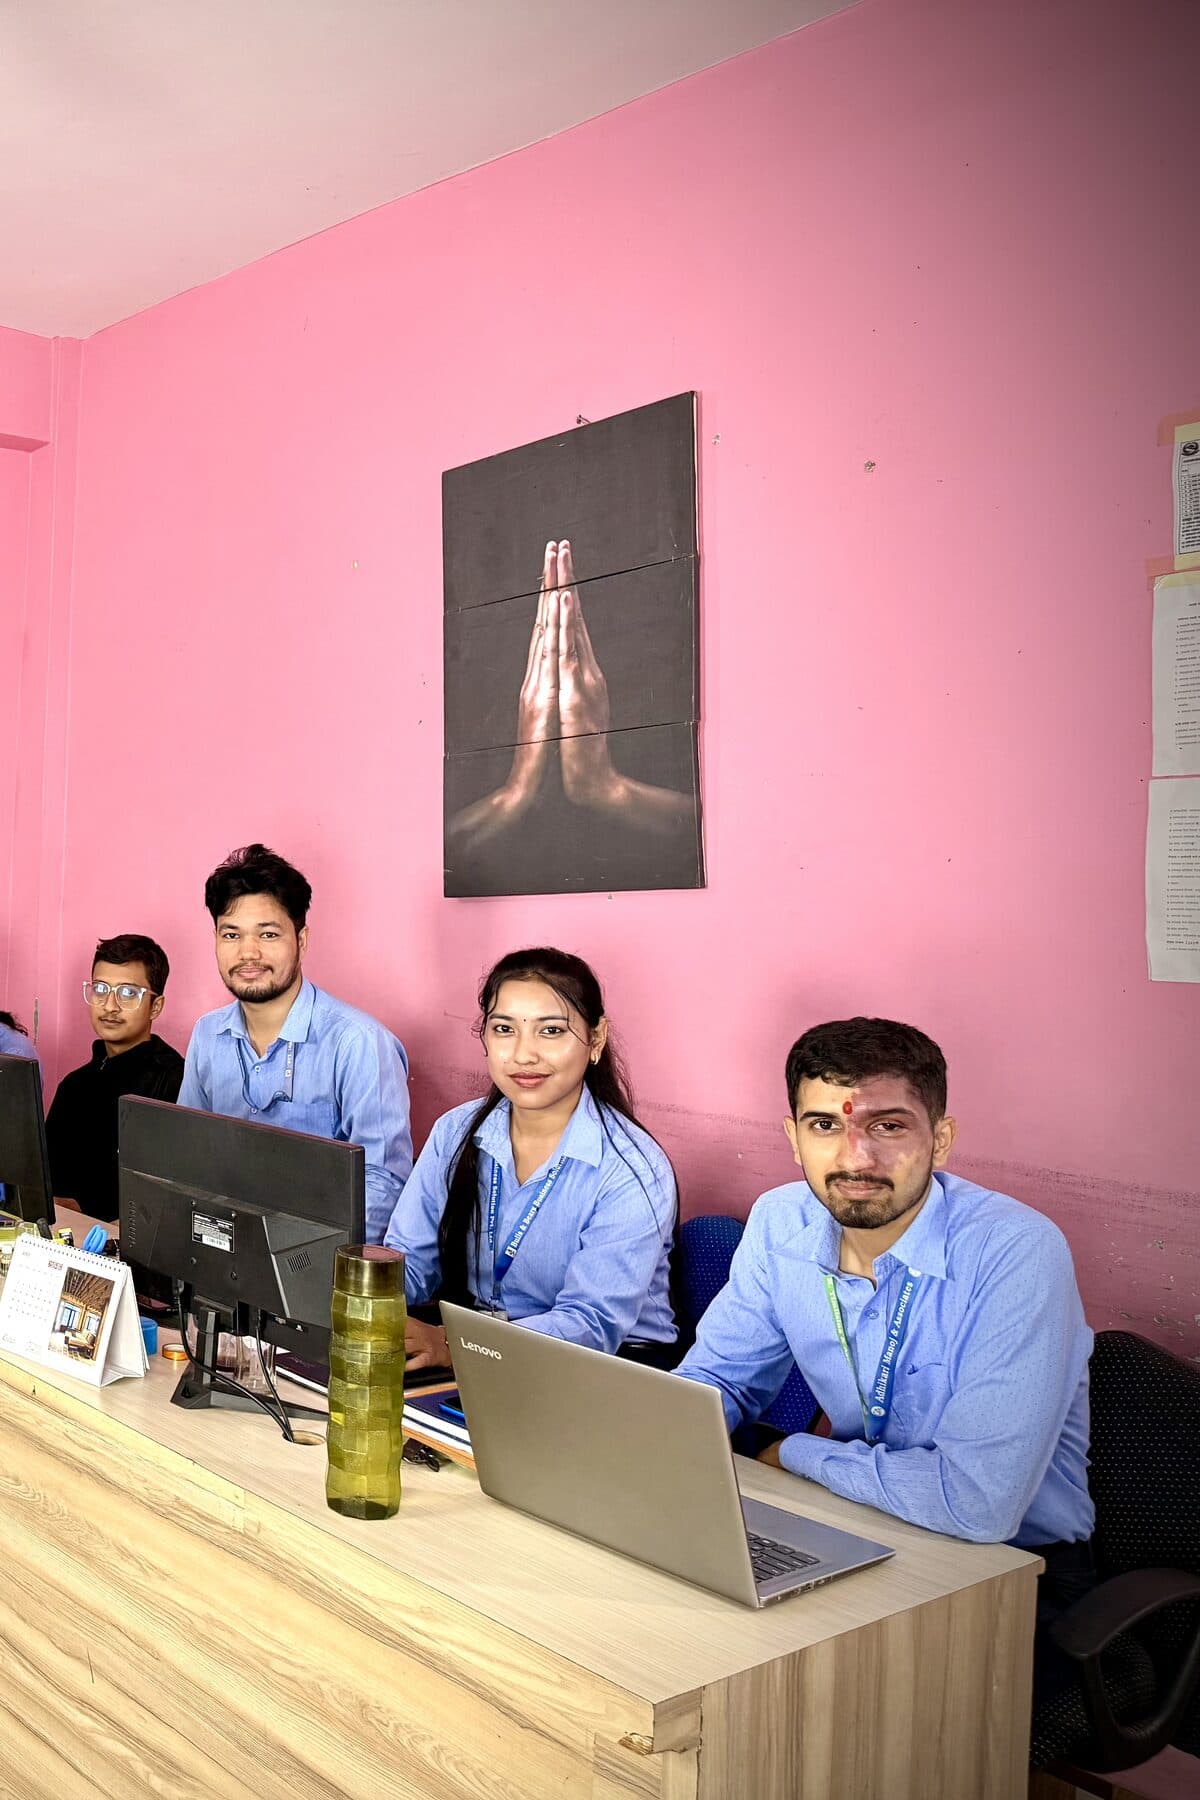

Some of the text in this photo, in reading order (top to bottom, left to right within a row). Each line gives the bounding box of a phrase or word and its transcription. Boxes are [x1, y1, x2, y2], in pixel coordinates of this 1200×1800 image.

[460, 1336, 502, 1360] Lenovo
[874, 1281, 914, 1403] Adhikari Manoj & Associates
